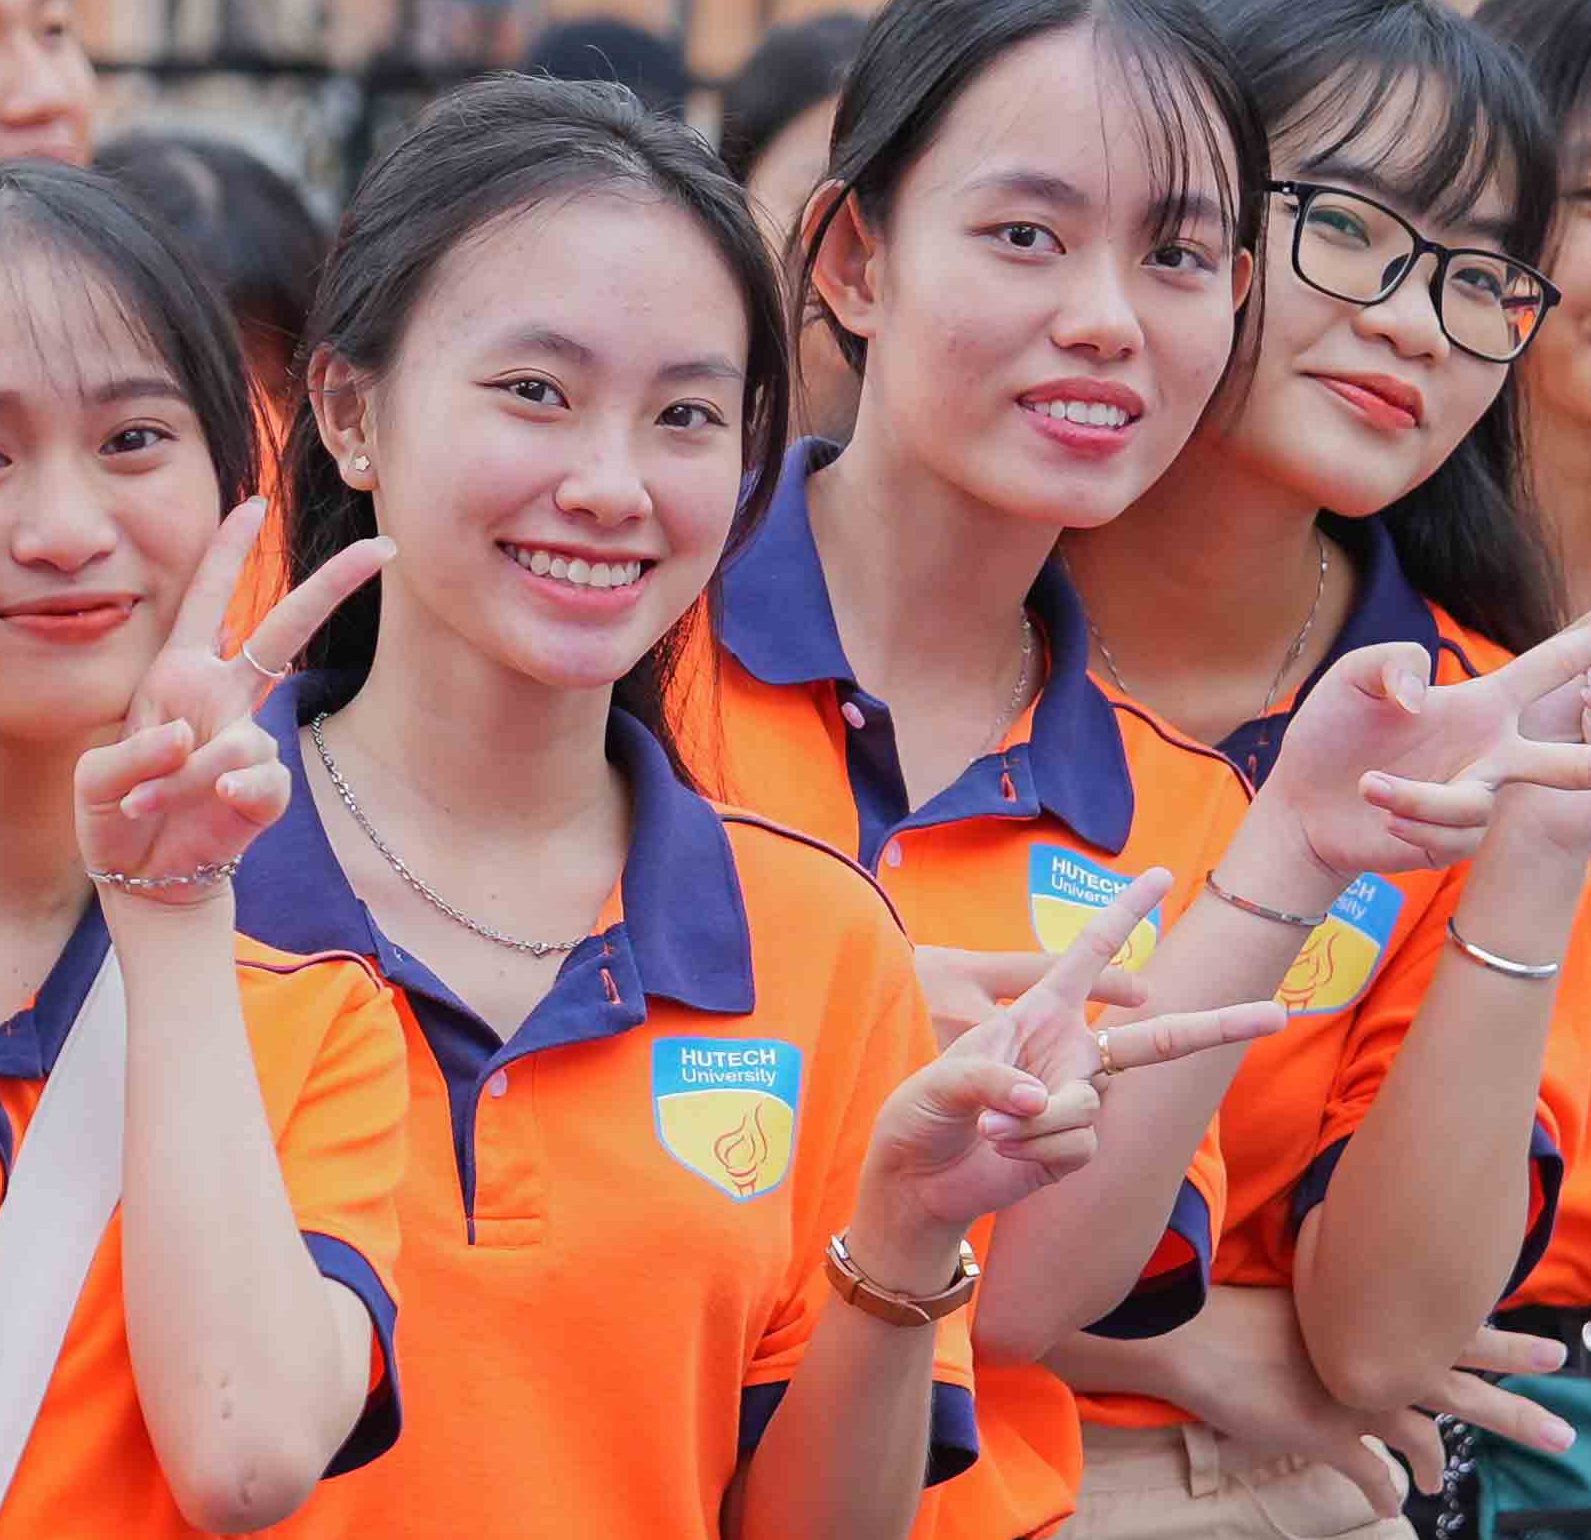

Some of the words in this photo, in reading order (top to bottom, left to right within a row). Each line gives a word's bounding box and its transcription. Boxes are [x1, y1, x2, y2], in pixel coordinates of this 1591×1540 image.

[1051, 855, 1127, 894] HUTECH
[680, 1047, 777, 1068] HUTECH
[681, 1067, 777, 1087] University
